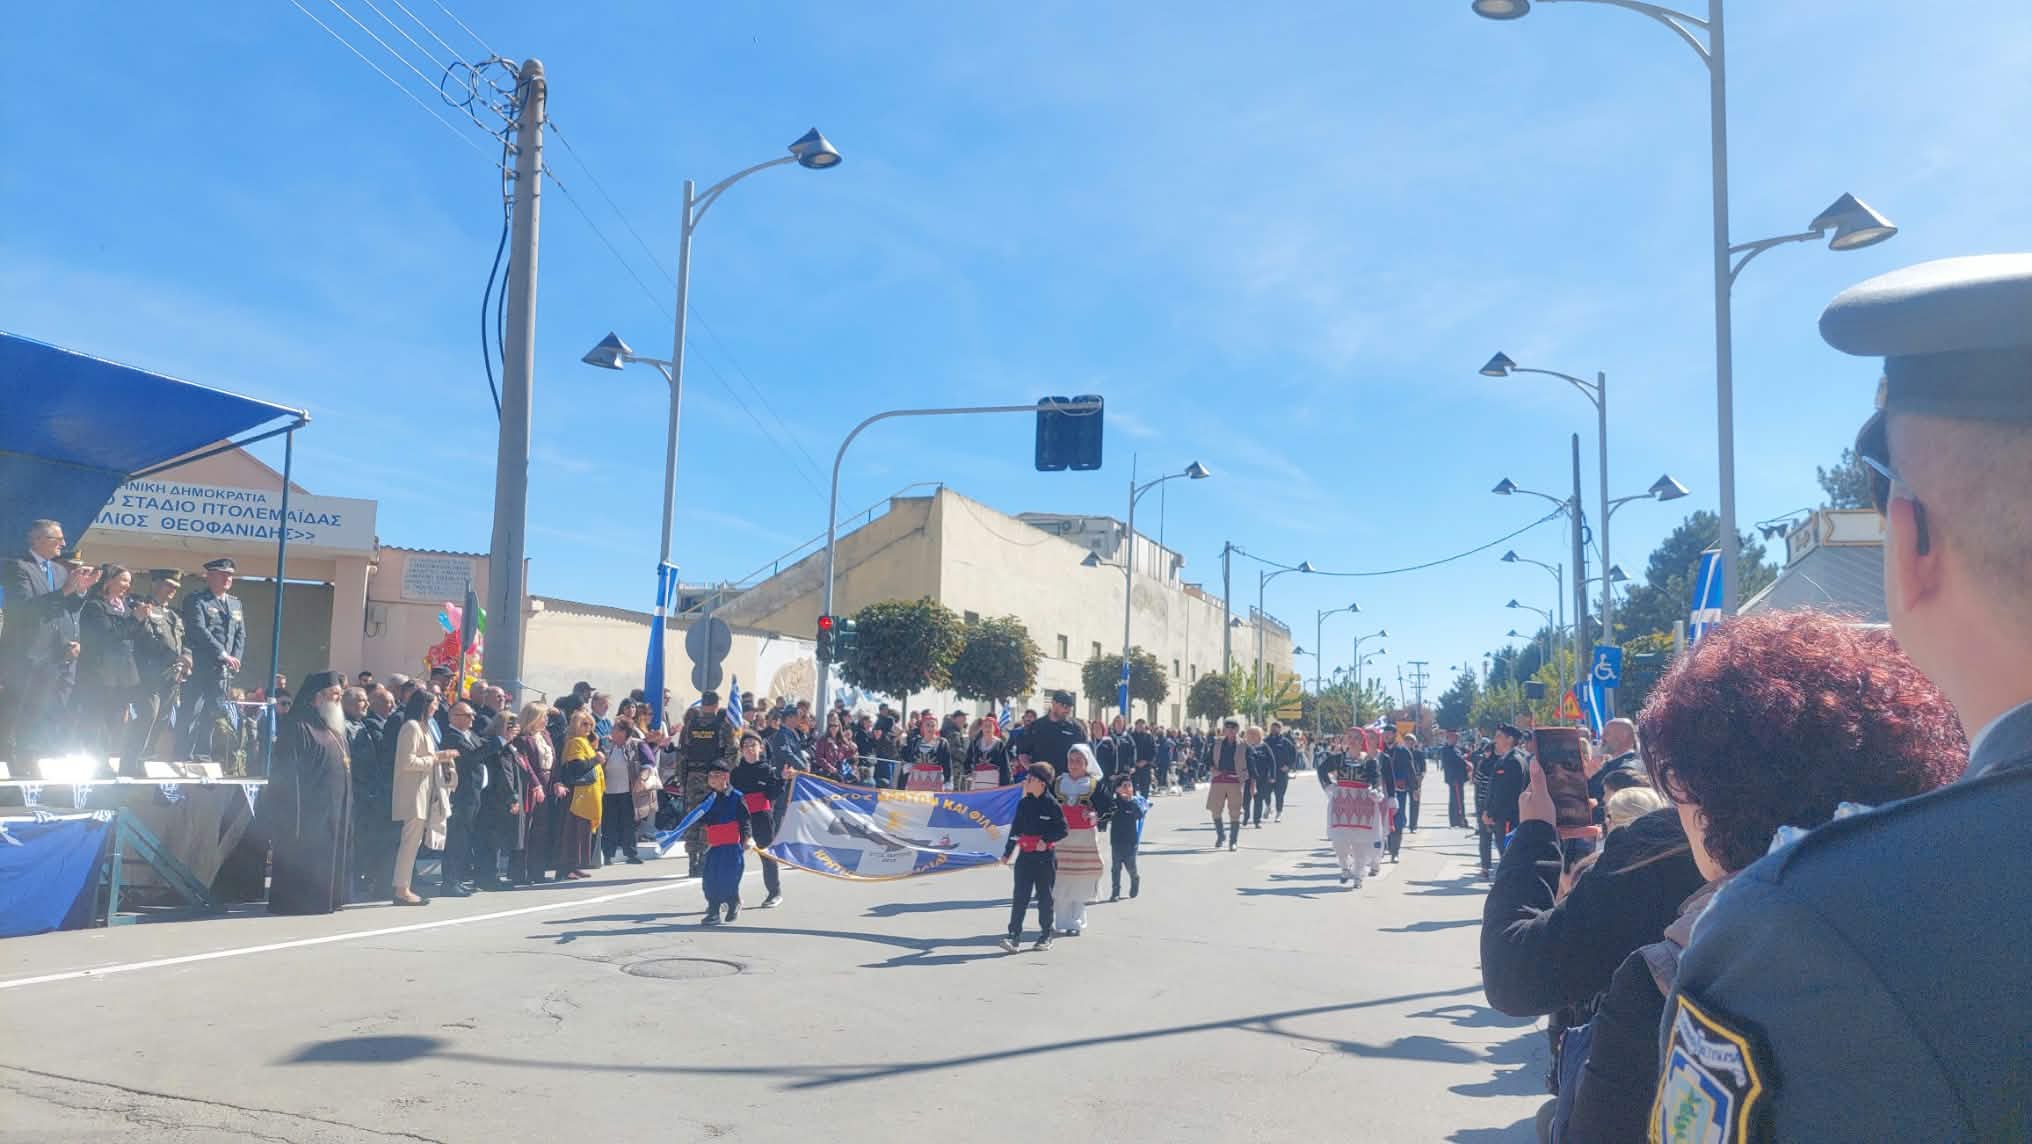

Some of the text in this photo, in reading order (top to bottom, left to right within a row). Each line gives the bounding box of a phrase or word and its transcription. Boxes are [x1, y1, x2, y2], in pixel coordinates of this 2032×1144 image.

[169, 485, 267, 504] ΔΗΜΟΚΡΑΤΙΑ
[121, 495, 196, 513] ΣΤΑΔΙΟ
[202, 502, 342, 527] ΠΤΟΛΕΜΑΪΔΑΣ
[943, 798, 969, 815] ΚΑΙ
